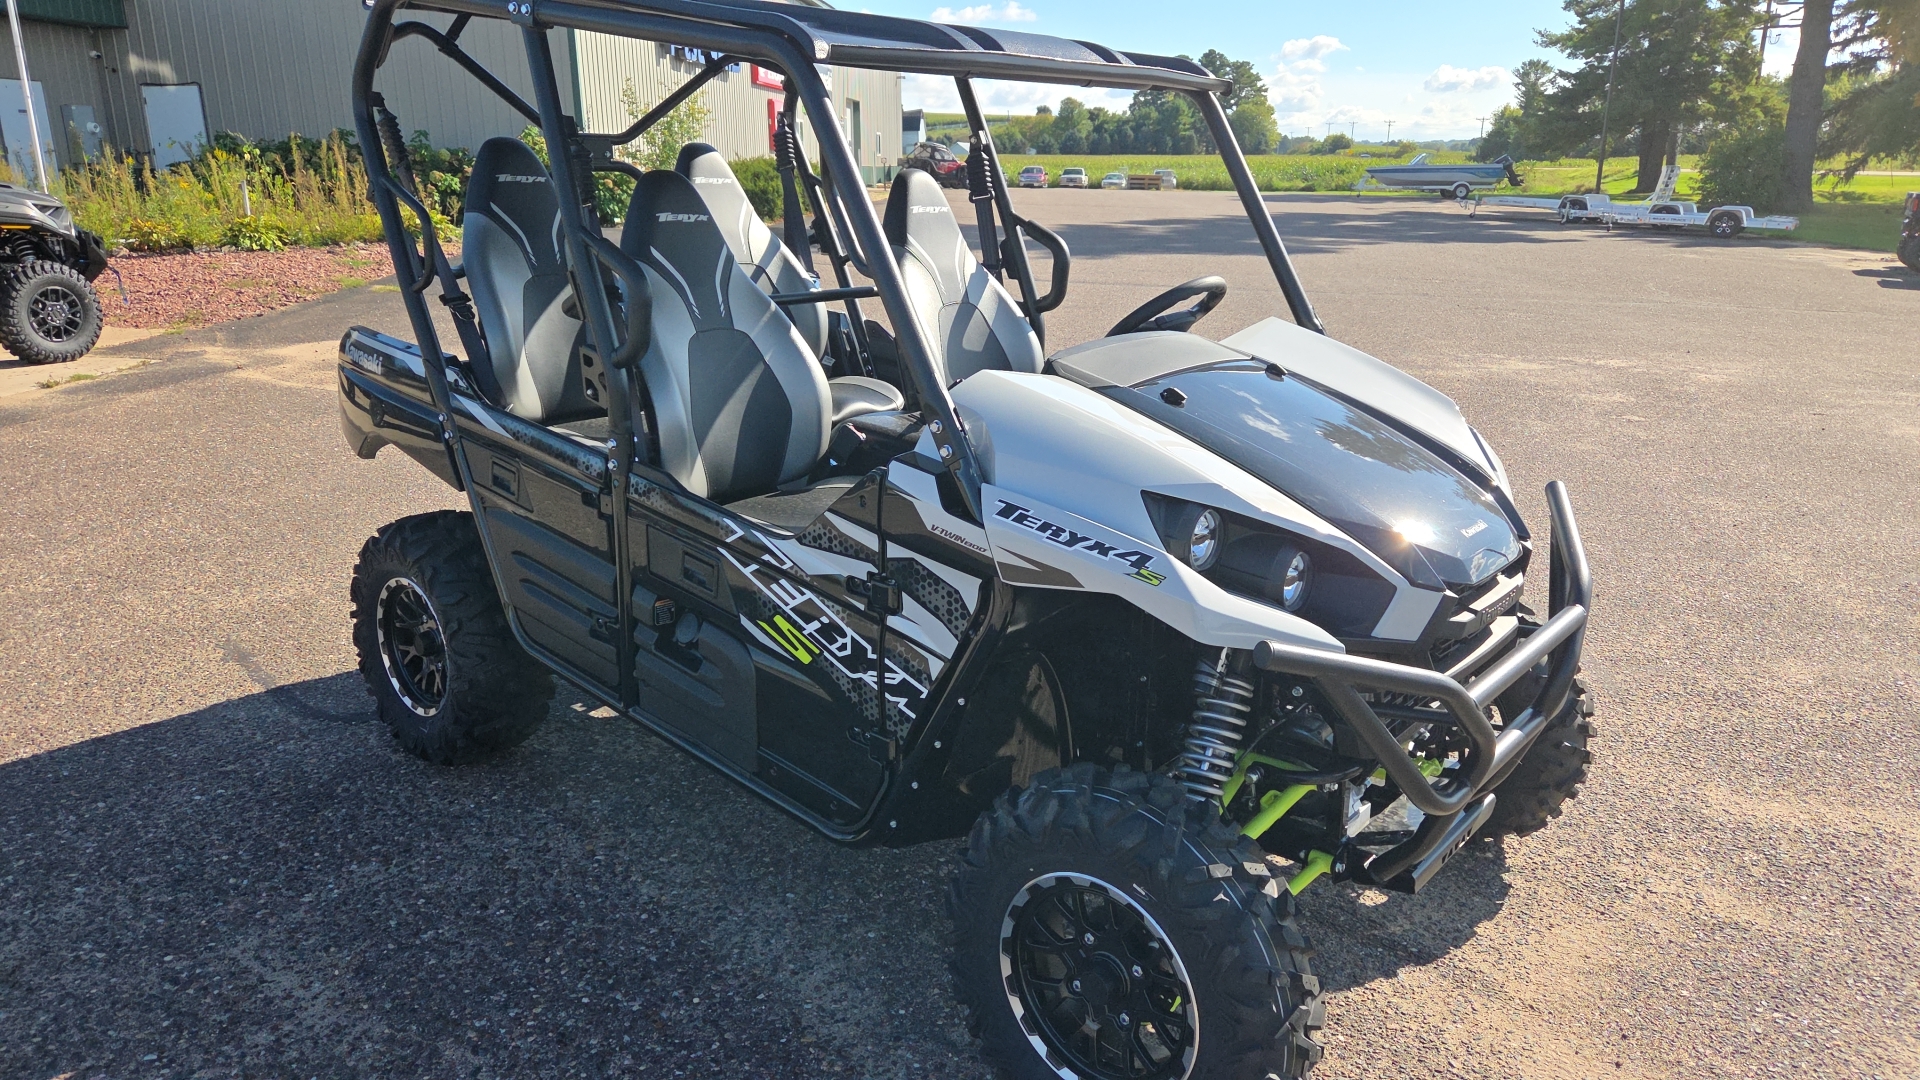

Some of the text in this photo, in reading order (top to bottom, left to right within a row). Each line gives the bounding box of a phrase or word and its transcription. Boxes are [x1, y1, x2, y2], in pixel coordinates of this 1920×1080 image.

[495, 174, 547, 183] TERYX
[693, 176, 733, 185] TERYX
[910, 205, 949, 214] TERYX
[655, 212, 709, 223] TERYX
[345, 338, 383, 375] Kawasaki
